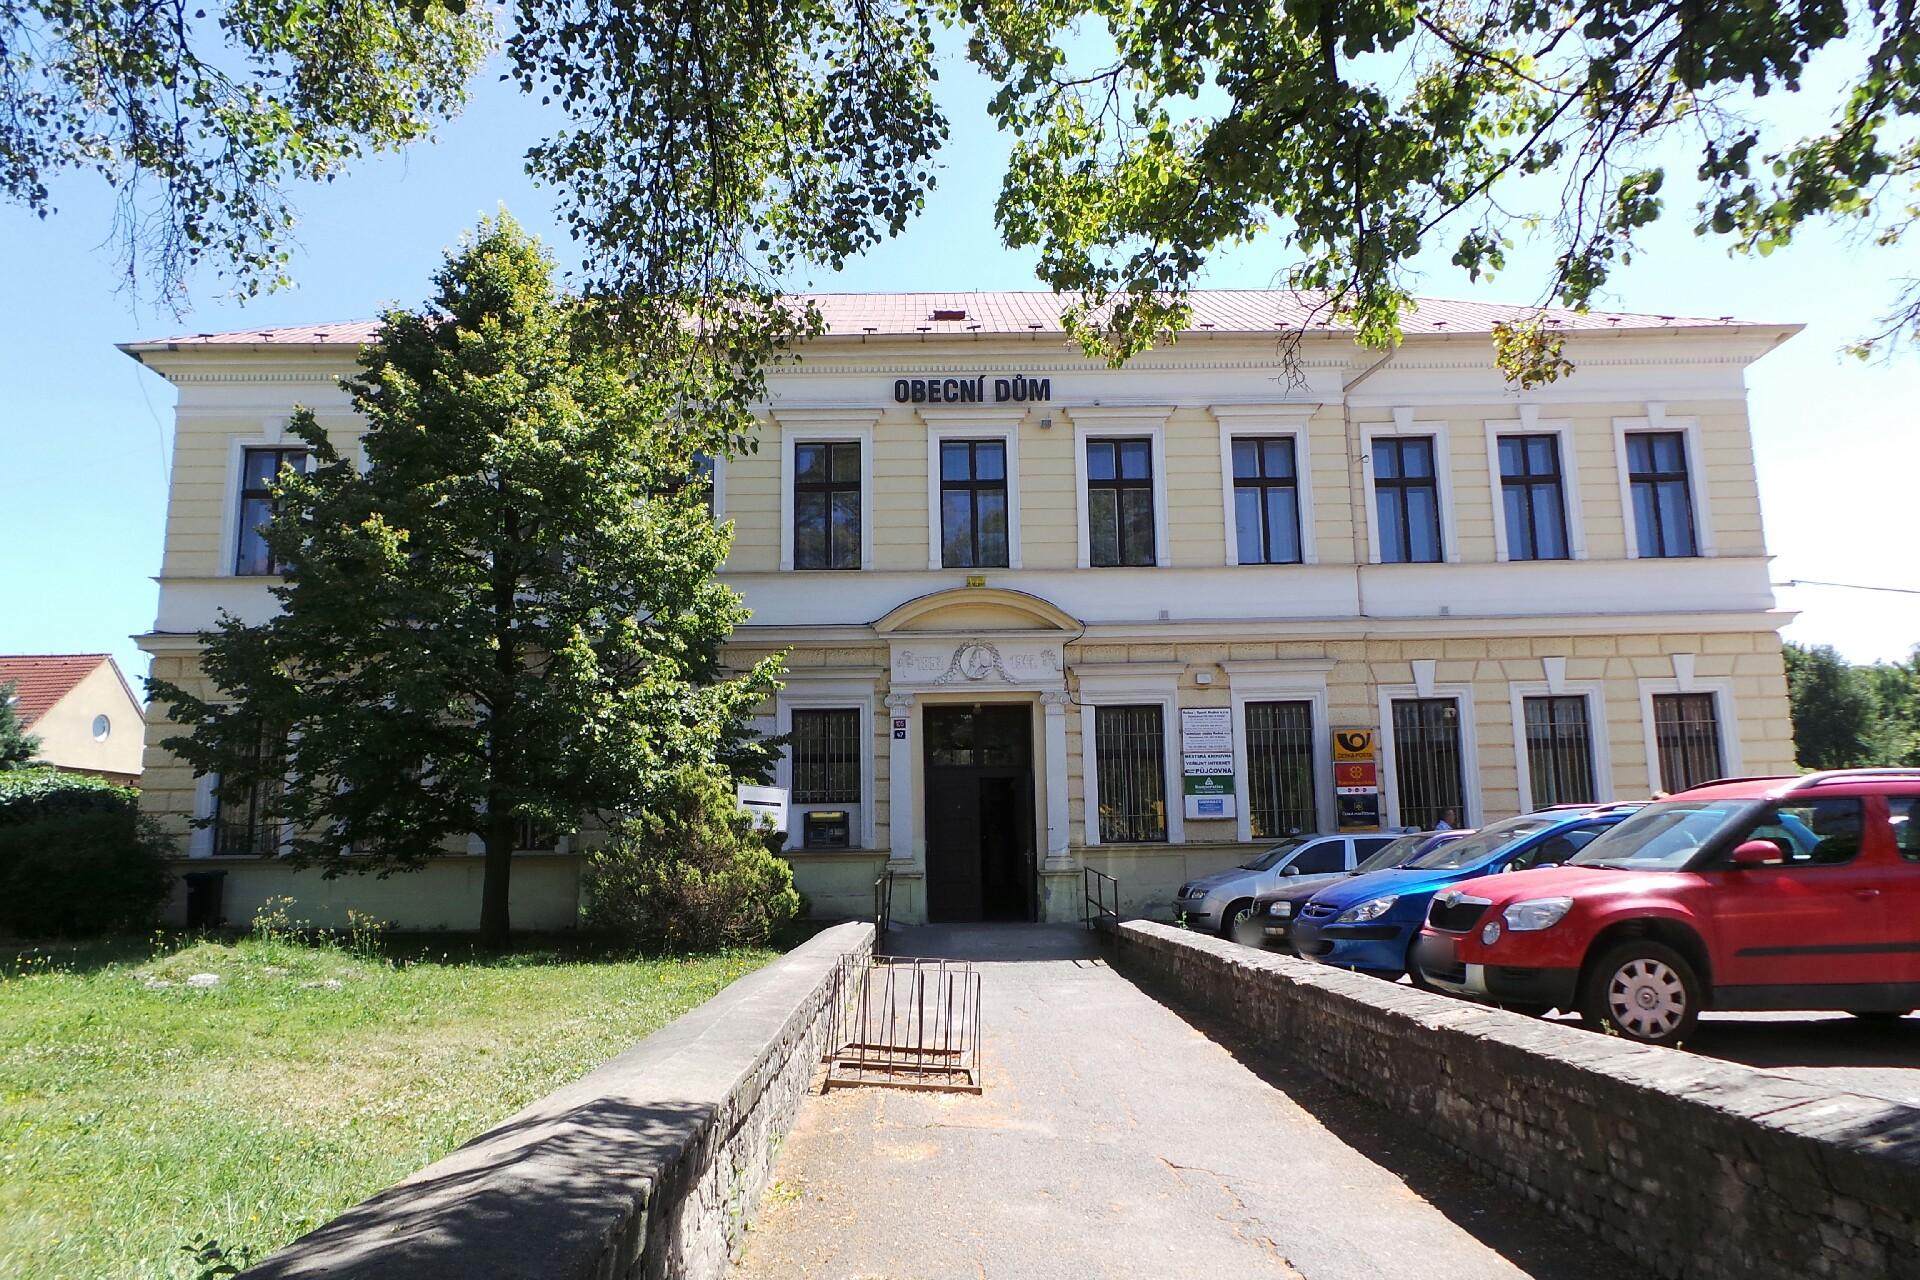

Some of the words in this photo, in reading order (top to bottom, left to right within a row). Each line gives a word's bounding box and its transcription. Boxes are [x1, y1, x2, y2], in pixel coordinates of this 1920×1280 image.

[894, 375, 986, 403] OBECNÍ
[994, 374, 1050, 402] DŮM
[1195, 766, 1232, 774] PŮJČOVNA
